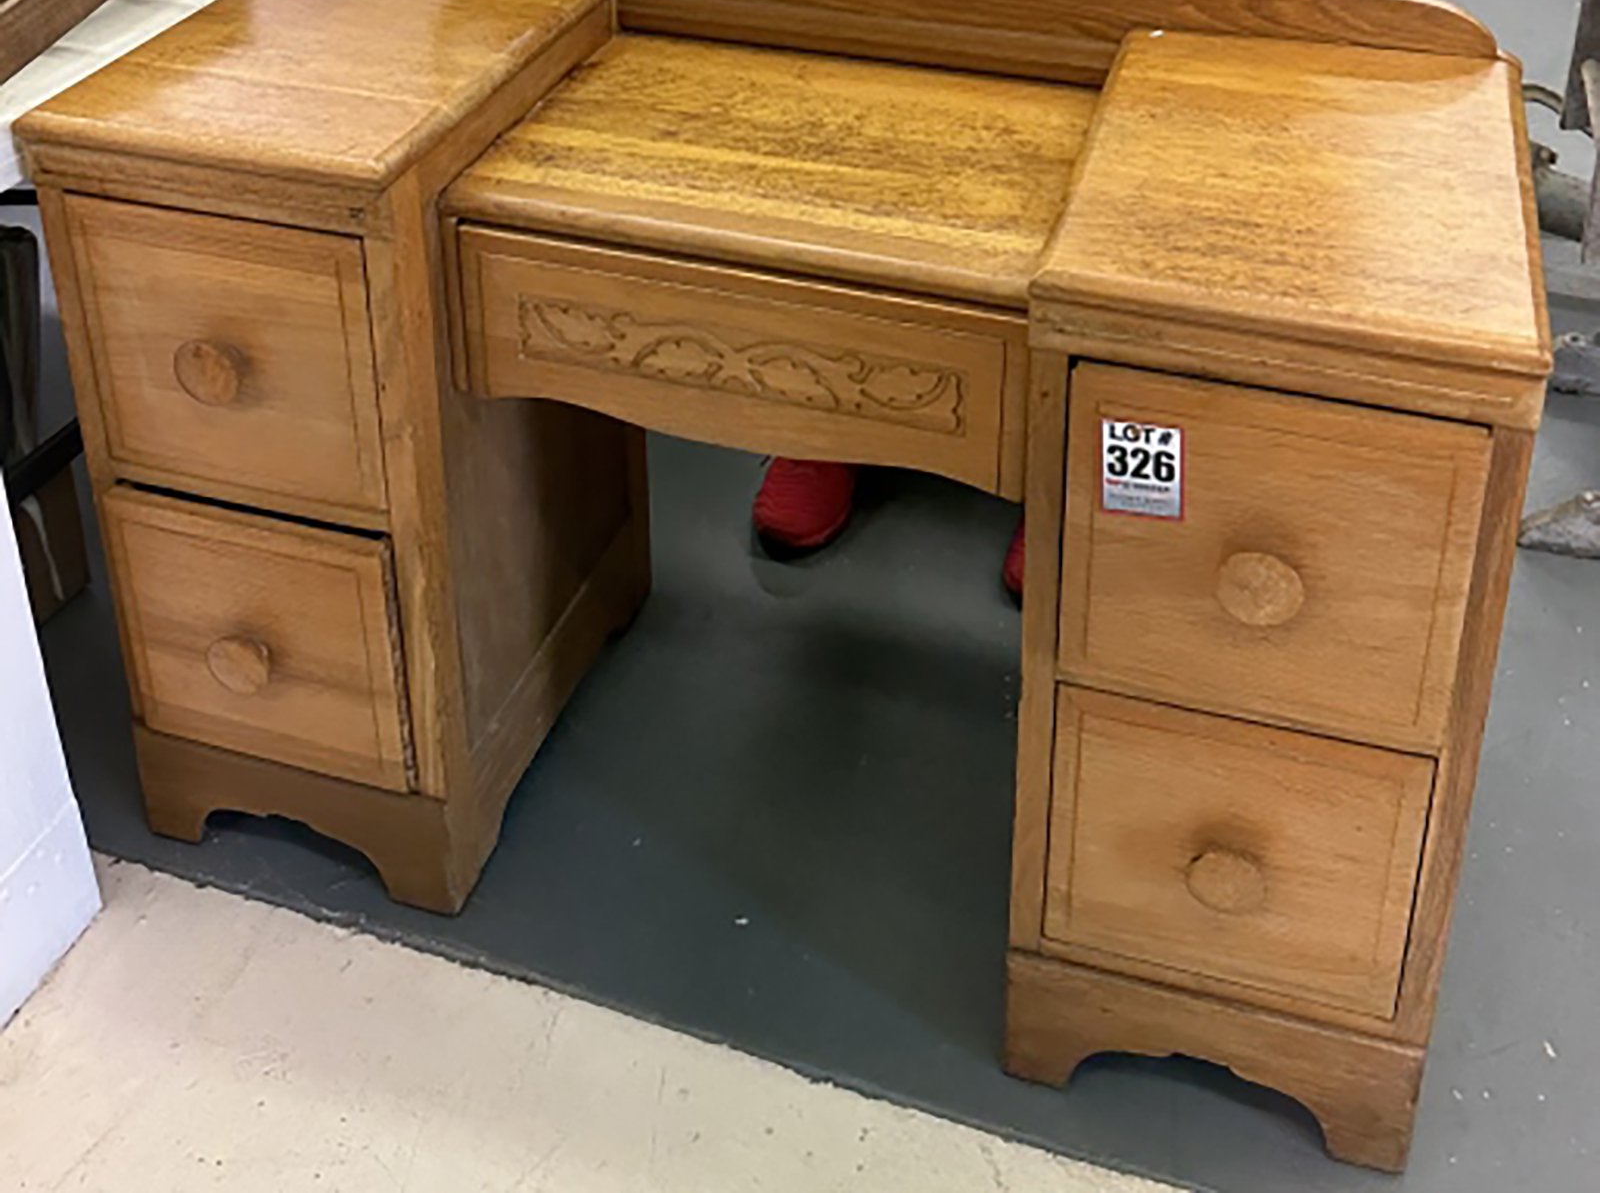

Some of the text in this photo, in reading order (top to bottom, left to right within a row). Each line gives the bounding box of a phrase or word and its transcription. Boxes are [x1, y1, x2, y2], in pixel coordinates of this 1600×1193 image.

[1109, 423, 1173, 445] LOT #
[1106, 444, 1175, 482] 326
